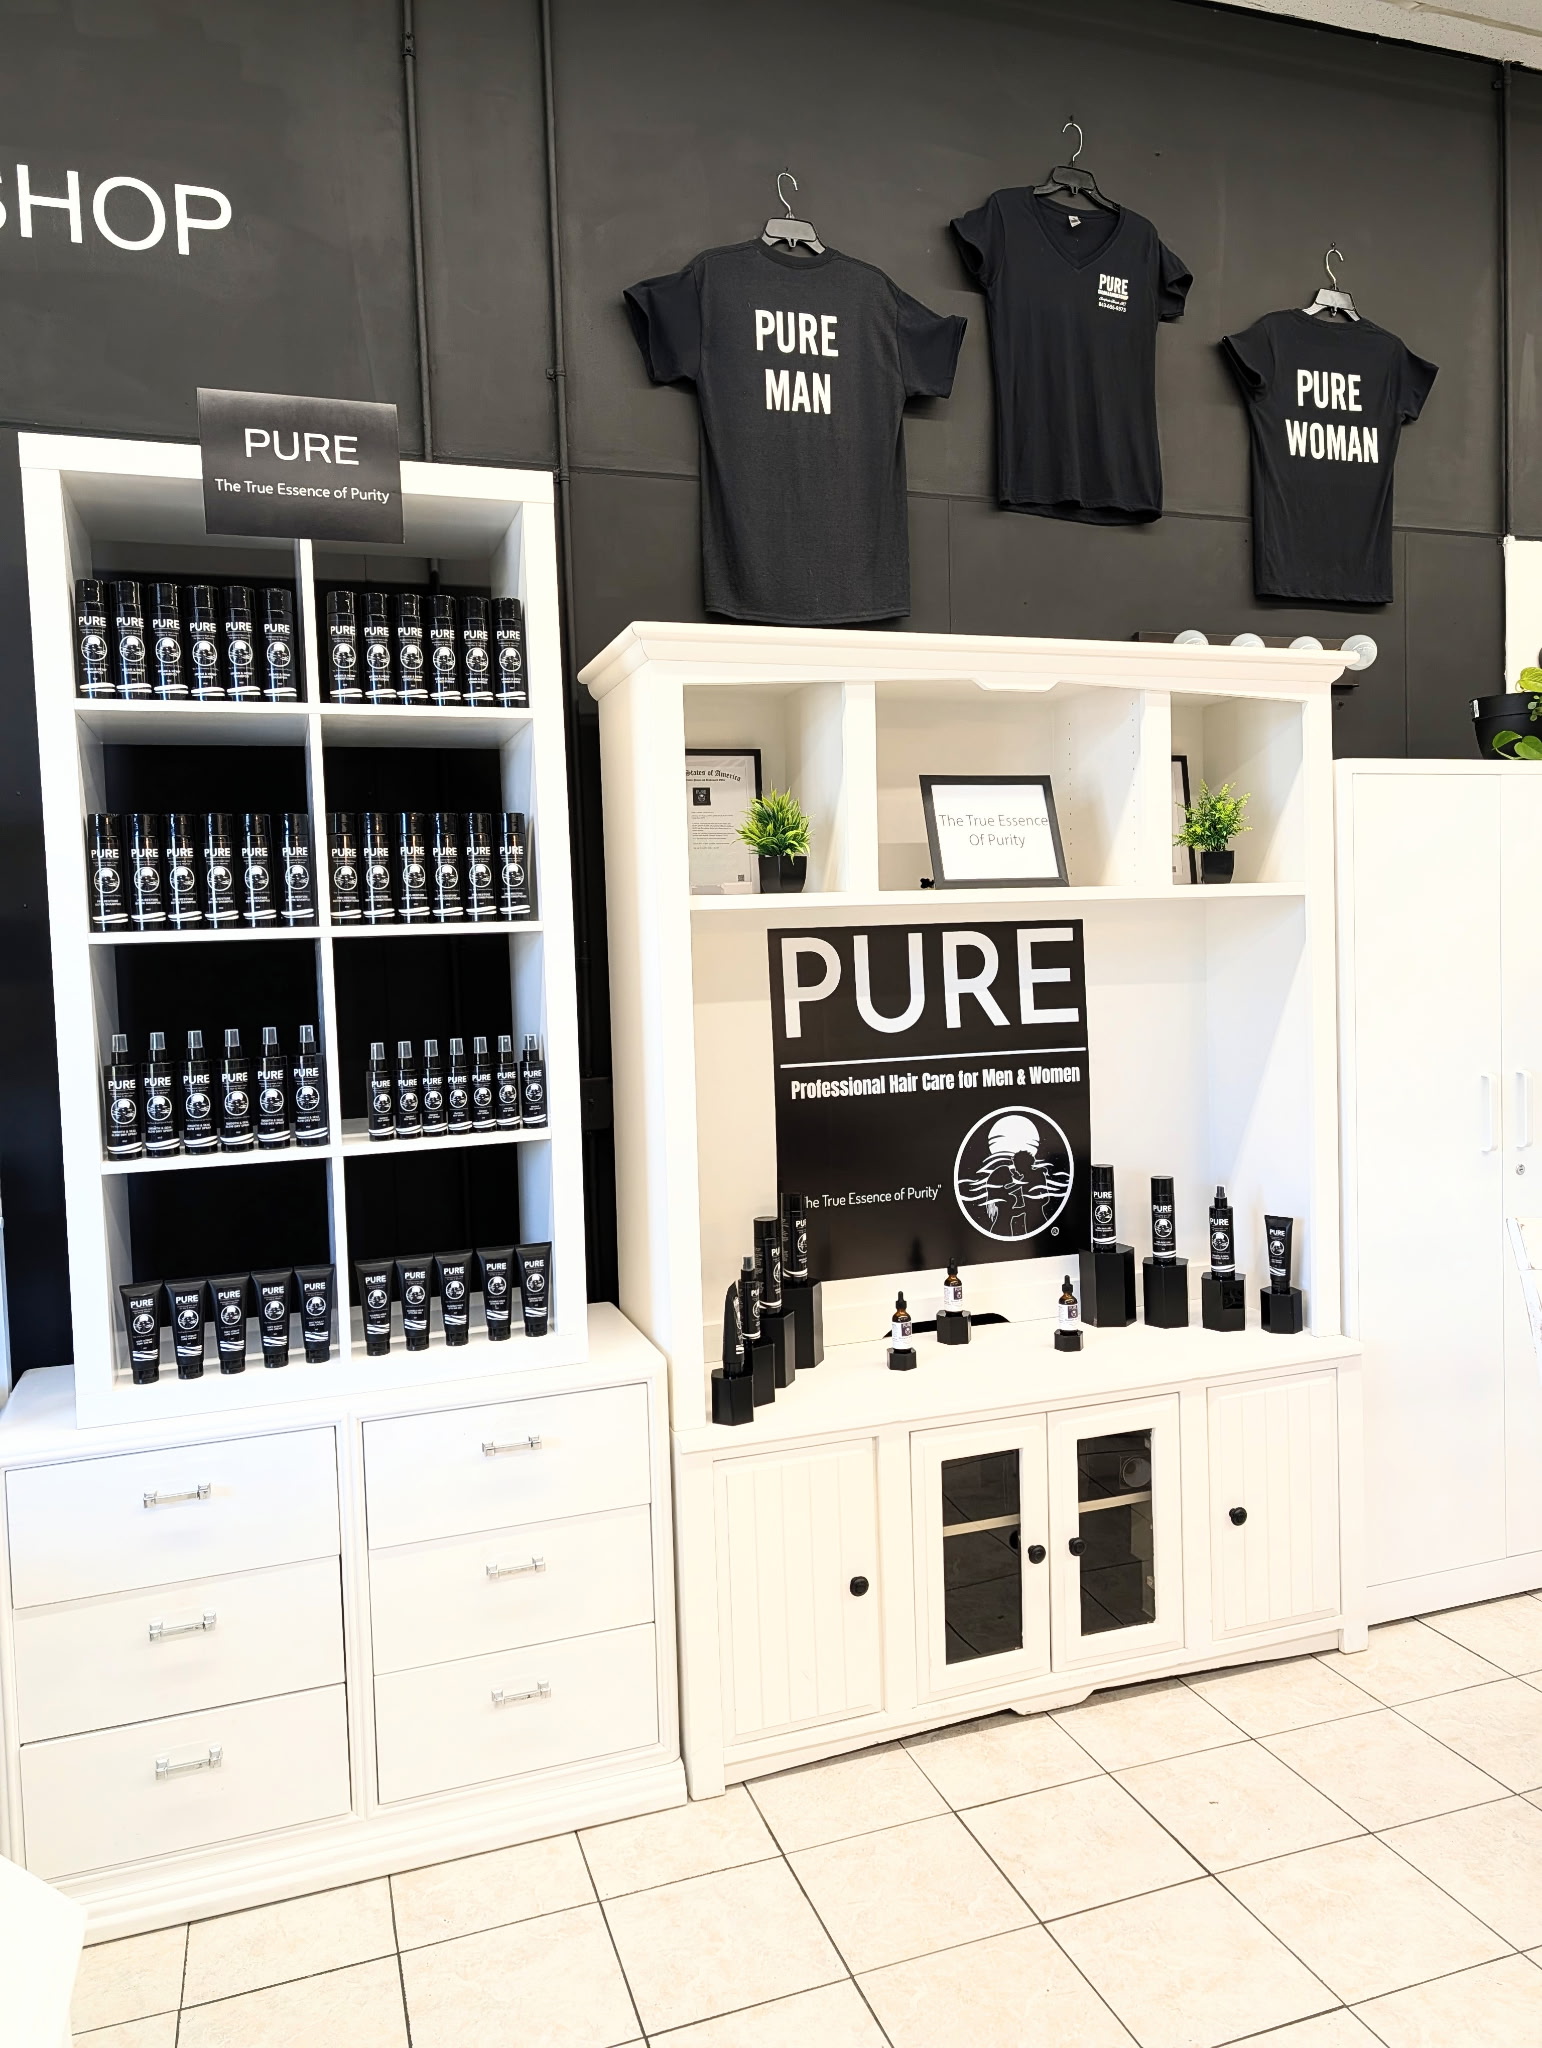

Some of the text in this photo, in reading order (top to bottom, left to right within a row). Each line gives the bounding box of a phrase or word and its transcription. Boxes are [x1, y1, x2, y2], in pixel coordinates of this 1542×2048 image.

[0, 164, 232, 255] HOP
[1099, 273, 1129, 296] PURE
[755, 309, 839, 357] PURE
[765, 368, 831, 415] MAN
[1297, 369, 1363, 412] PURE
[1285, 418, 1379, 464] WOMAN
[244, 427, 360, 466] PURE
[214, 478, 390, 505] The True Essence of Purity
[78, 615, 107, 627] PURE
[116, 616, 145, 628] PURE
[152, 618, 180, 629] PURE
[189, 621, 217, 633] PURE
[225, 621, 253, 632] PURE
[263, 623, 291, 634] PURE
[330, 625, 356, 636] PURE
[364, 626, 389, 637] PURE
[397, 627, 423, 637] PURE
[430, 629, 455, 639] PURE
[463, 630, 488, 640] PURE
[496, 630, 521, 640] PURE
[714, 769, 742, 782] America
[938, 814, 1049, 827] The True Essence
[969, 833, 1026, 849] Of Purity
[91, 848, 120, 859] PURE
[130, 848, 159, 858] PURE
[166, 847, 194, 857] PURE
[203, 847, 231, 857] PURE
[241, 847, 269, 857] PURE
[282, 846, 309, 856] PURE
[331, 847, 357, 857] PURE
[363, 847, 389, 857] PURE
[400, 846, 425, 856] PURE
[432, 847, 458, 856] PURE
[466, 846, 491, 856] PURE
[499, 845, 524, 855] PURE
[780, 927, 1080, 1039] PURE
[221, 1071, 248, 1082] PURE
[257, 1069, 284, 1080] PURE
[293, 1067, 319, 1077] PURE
[497, 1071, 516, 1080] PURE
[523, 1070, 542, 1078] PURE
[144, 1076, 171, 1087] PURE
[183, 1074, 210, 1084] PURE
[398, 1078, 418, 1087] PURE
[422, 1077, 443, 1085] PURE
[448, 1075, 467, 1083] PURE
[472, 1074, 491, 1082] PURE
[791, 1065, 1081, 1100] Professional Hair Care for Men & Women
[108, 1079, 136, 1090] PURE
[371, 1080, 391, 1088] PURE
[804, 1184, 942, 1208] he True Essence of Purity"
[1093, 1191, 1112, 1199] PURE
[1152, 1204, 1172, 1213] PURE
[1209, 1217, 1229, 1226] PURE
[1269, 1228, 1285, 1237] PURE
[486, 1262, 507, 1271] PURE
[524, 1259, 545, 1268] PURE
[404, 1271, 426, 1280] PURE
[443, 1266, 465, 1275] PURE
[365, 1275, 387, 1284] PURE
[262, 1286, 285, 1295] PURE
[304, 1282, 326, 1291] PURE
[175, 1294, 199, 1304] PURE
[218, 1290, 241, 1300] PURE
[130, 1298, 154, 1309] PURE
